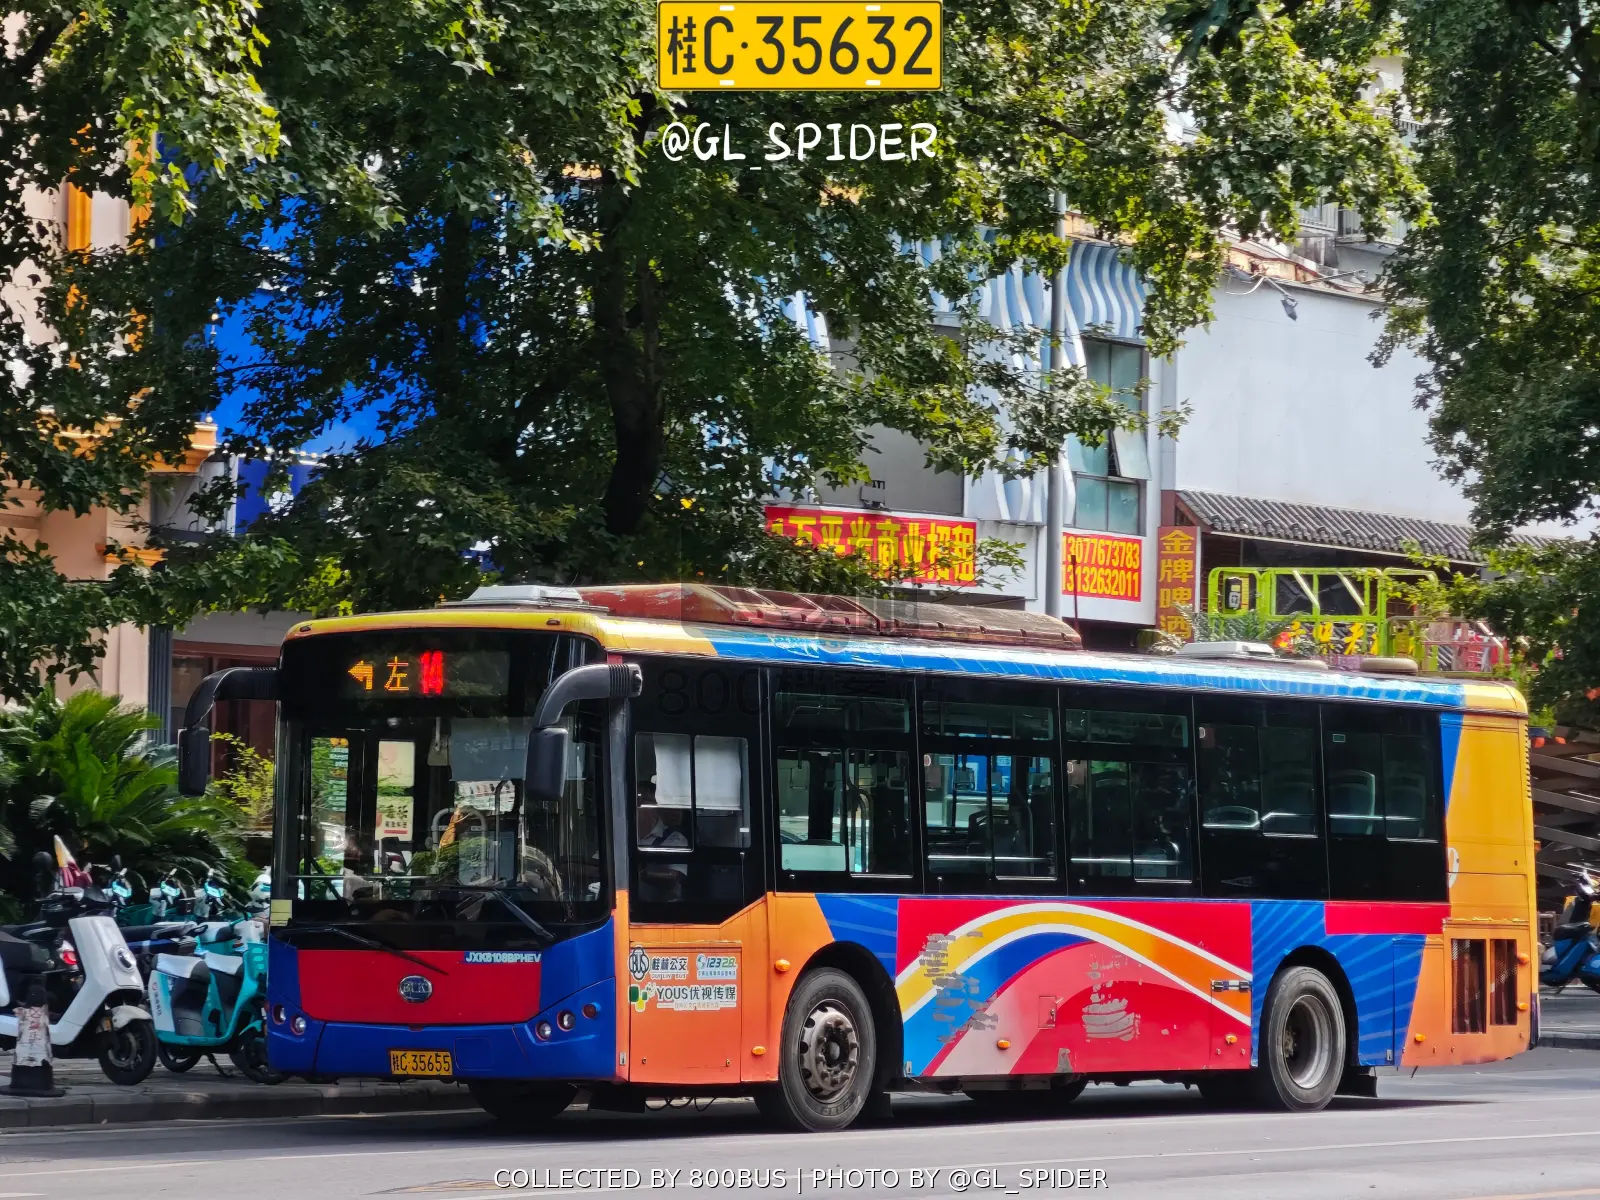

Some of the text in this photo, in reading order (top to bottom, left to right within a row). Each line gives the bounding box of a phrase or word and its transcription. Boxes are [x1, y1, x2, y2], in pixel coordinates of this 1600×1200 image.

[1062, 535, 1140, 570] 13077673783
[1061, 564, 1139, 598] 13132632011
[1159, 529, 1195, 640] 金牌啤酒
[384, 656, 409, 692] 左
[651, 957, 688, 971] 桂林公交
[656, 986, 737, 1001] YOUS优视传媒
